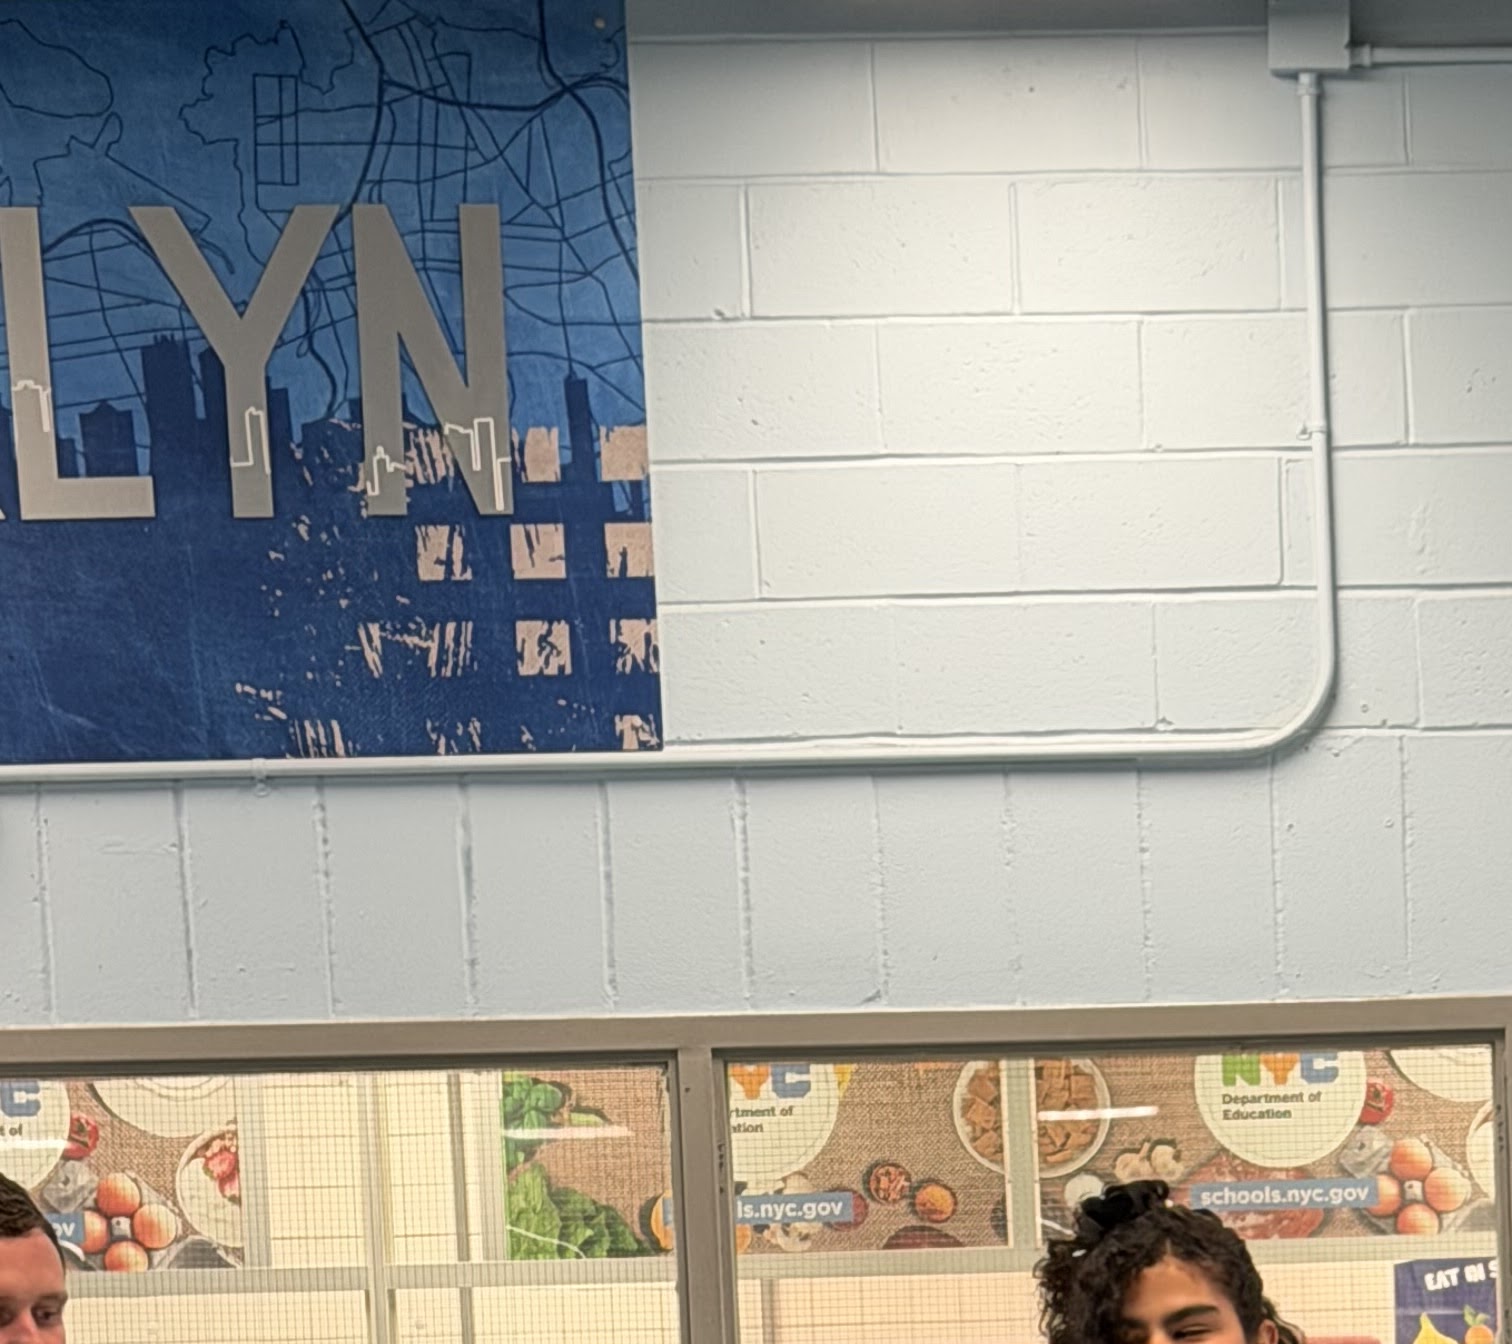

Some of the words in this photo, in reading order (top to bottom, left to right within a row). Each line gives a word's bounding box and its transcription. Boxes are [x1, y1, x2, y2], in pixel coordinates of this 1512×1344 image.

[0, 204, 514, 520] LYN
[1222, 1053, 1340, 1087] NYC
[731, 1064, 812, 1100] YC
[0, 1081, 41, 1117] C
[1222, 1091, 1304, 1106] Department
[1308, 1091, 1322, 1102] of
[730, 1106, 776, 1118] rtment
[780, 1105, 794, 1116] of
[1223, 1109, 1292, 1121] Education
[1200, 1185, 1369, 1207] schools.nyc.gov
[737, 1200, 843, 1219] ls.nyc.gov
[1424, 1267, 1460, 1291] EAT
